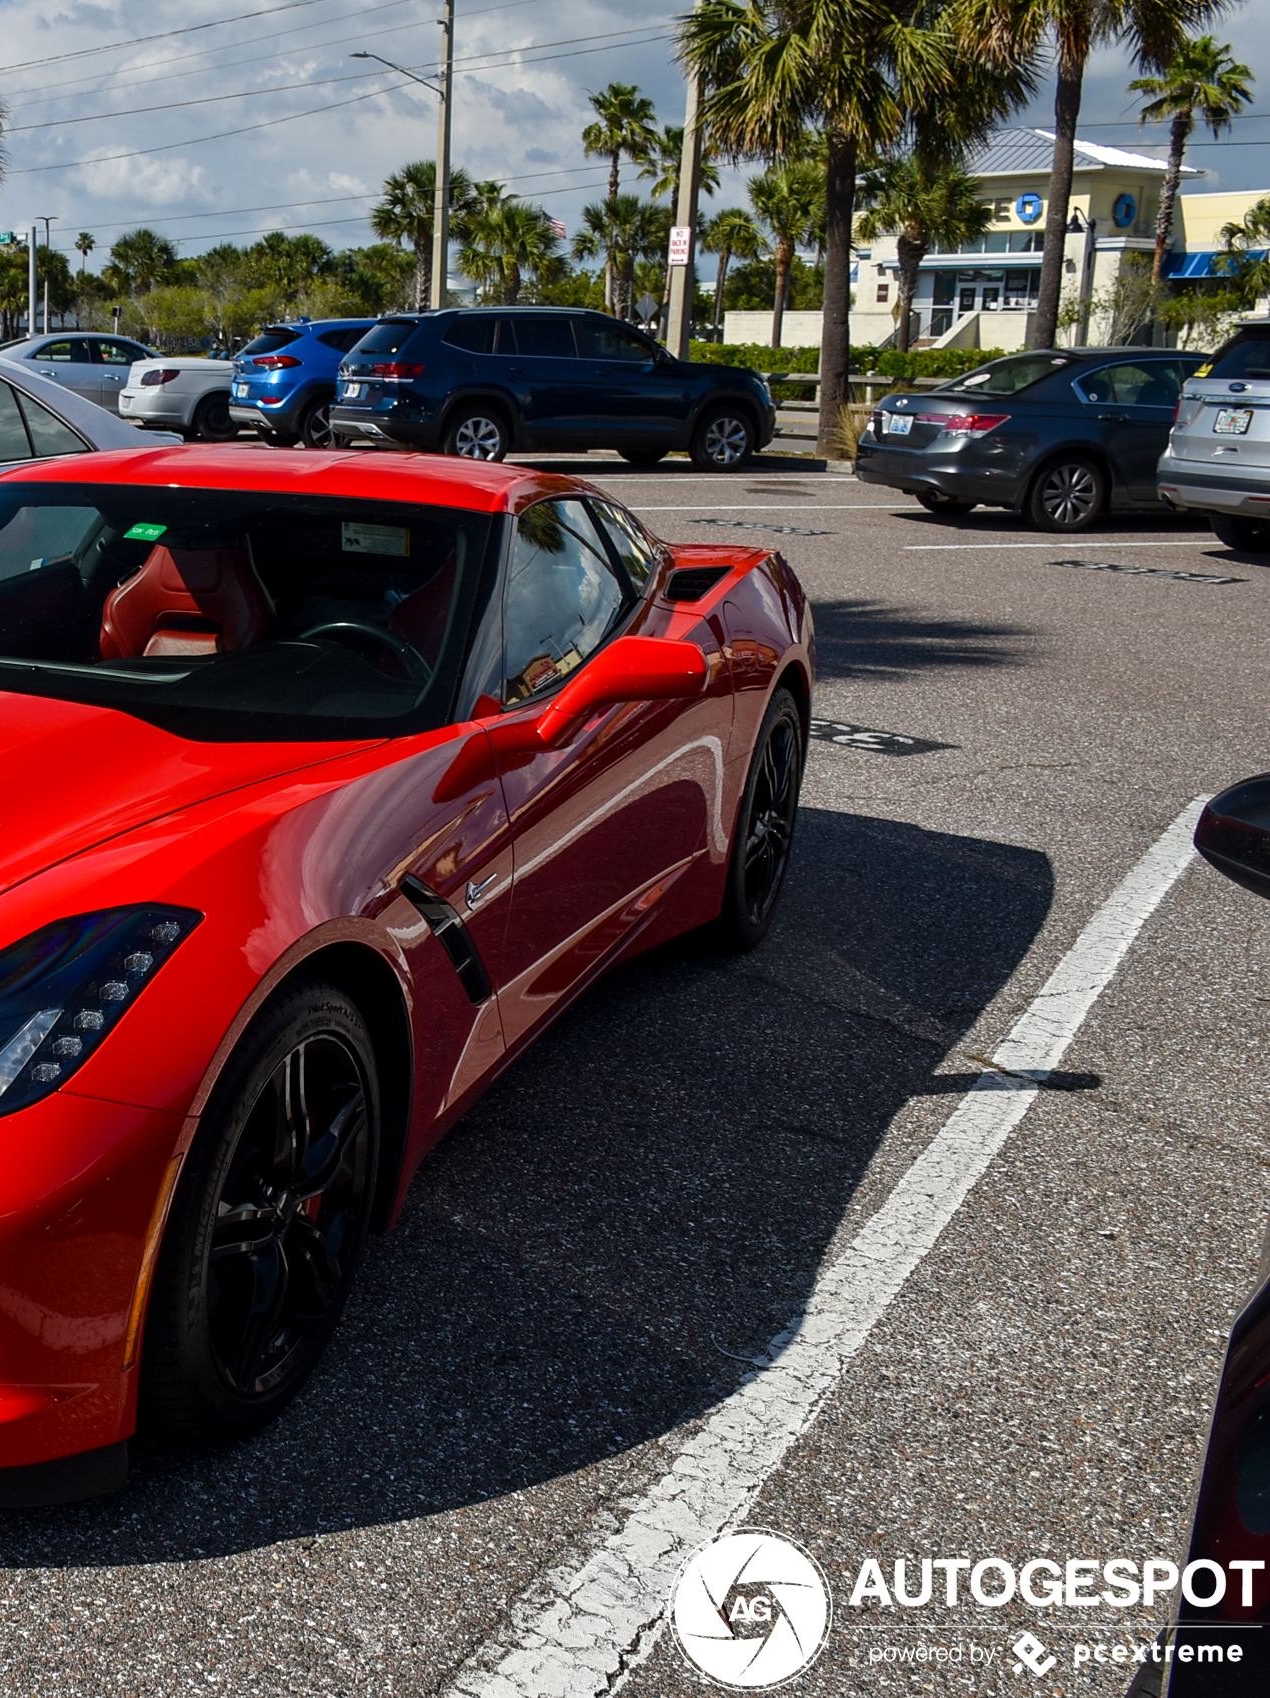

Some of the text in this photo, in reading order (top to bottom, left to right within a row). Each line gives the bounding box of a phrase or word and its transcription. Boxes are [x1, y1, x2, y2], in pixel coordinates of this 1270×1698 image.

[676, 230, 684, 238] NO
[672, 239, 681, 247] BACK
[670, 247, 687, 255] PARKING
[325, 1001, 343, 1015] Sport
[193, 1135, 230, 1258] MICHELIN
